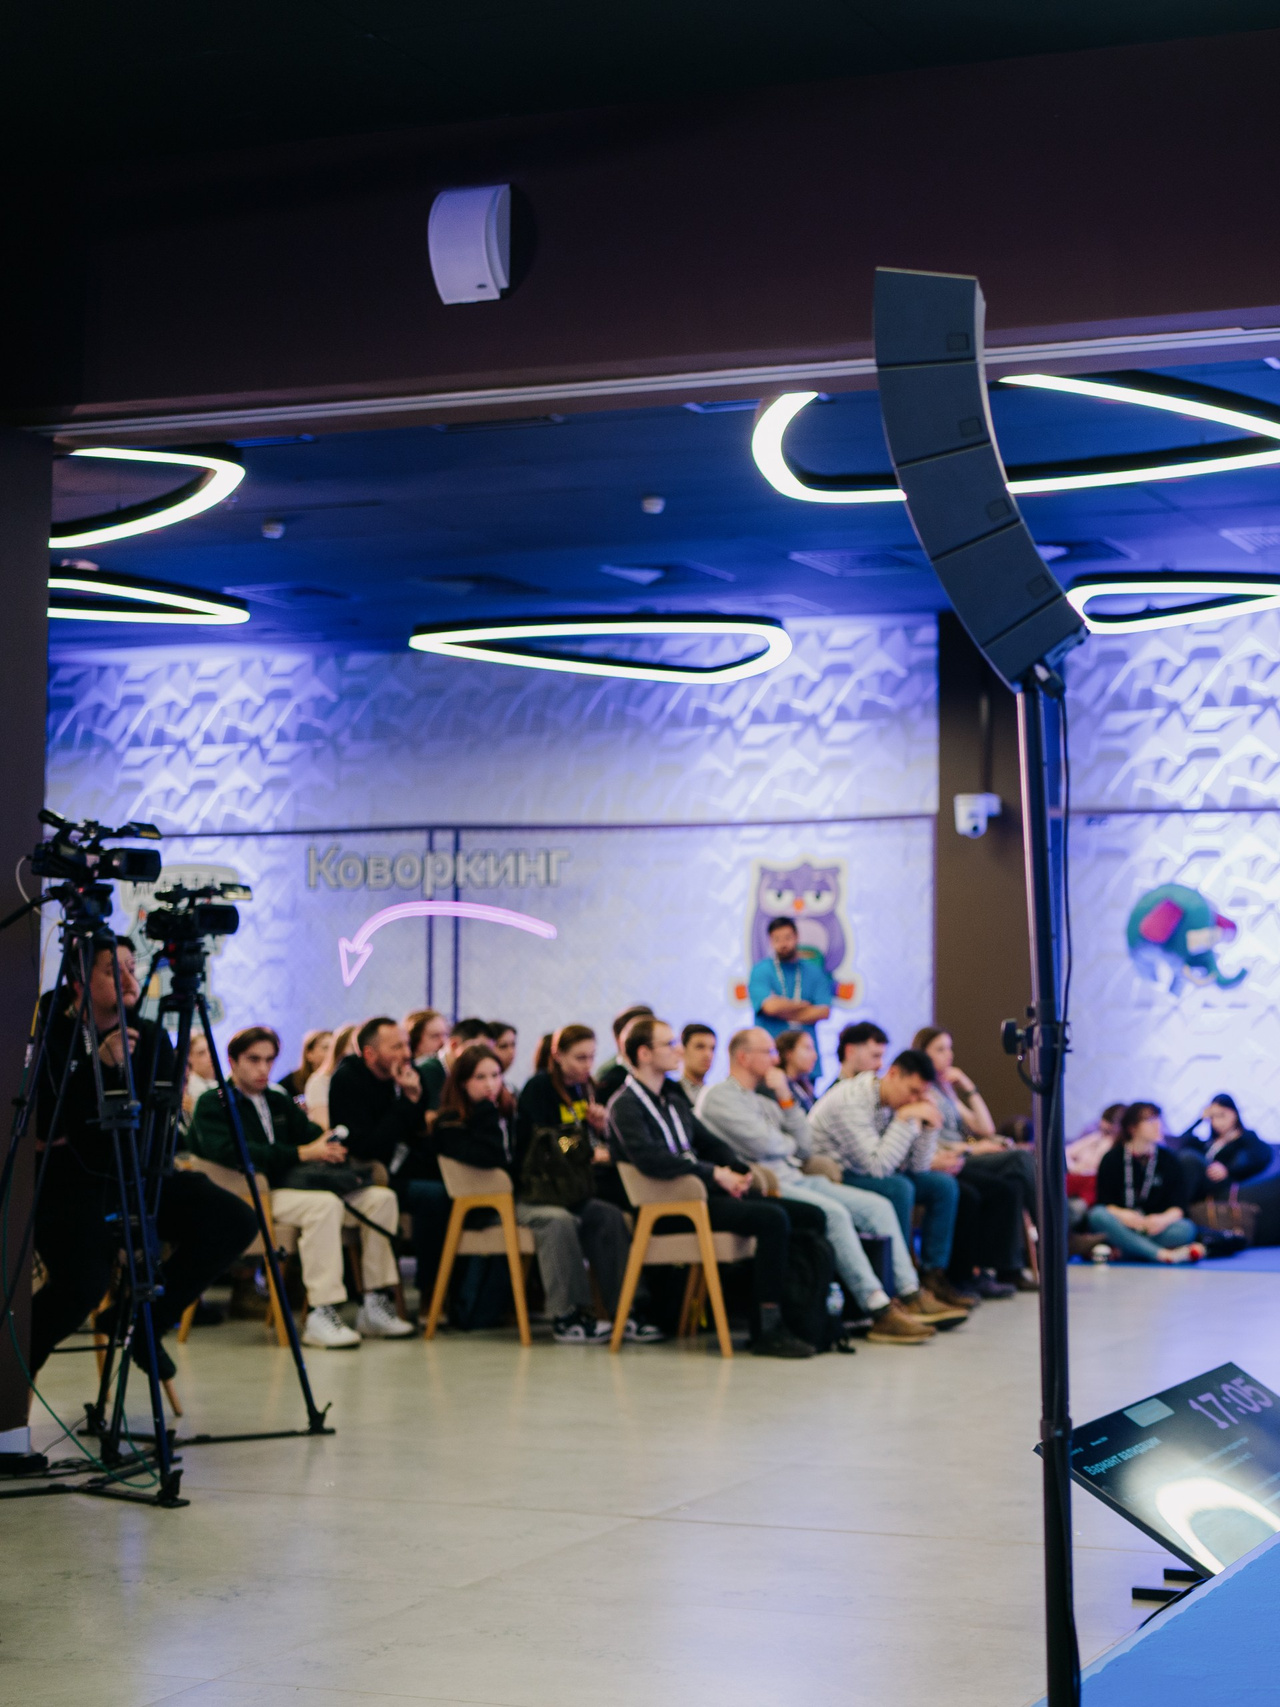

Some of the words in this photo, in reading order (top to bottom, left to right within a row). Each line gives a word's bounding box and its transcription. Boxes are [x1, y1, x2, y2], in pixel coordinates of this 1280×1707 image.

[308, 846, 569, 899] Коворкинг
[1188, 1377, 1273, 1429] 17:05
[1083, 1455, 1121, 1476] Вариант
